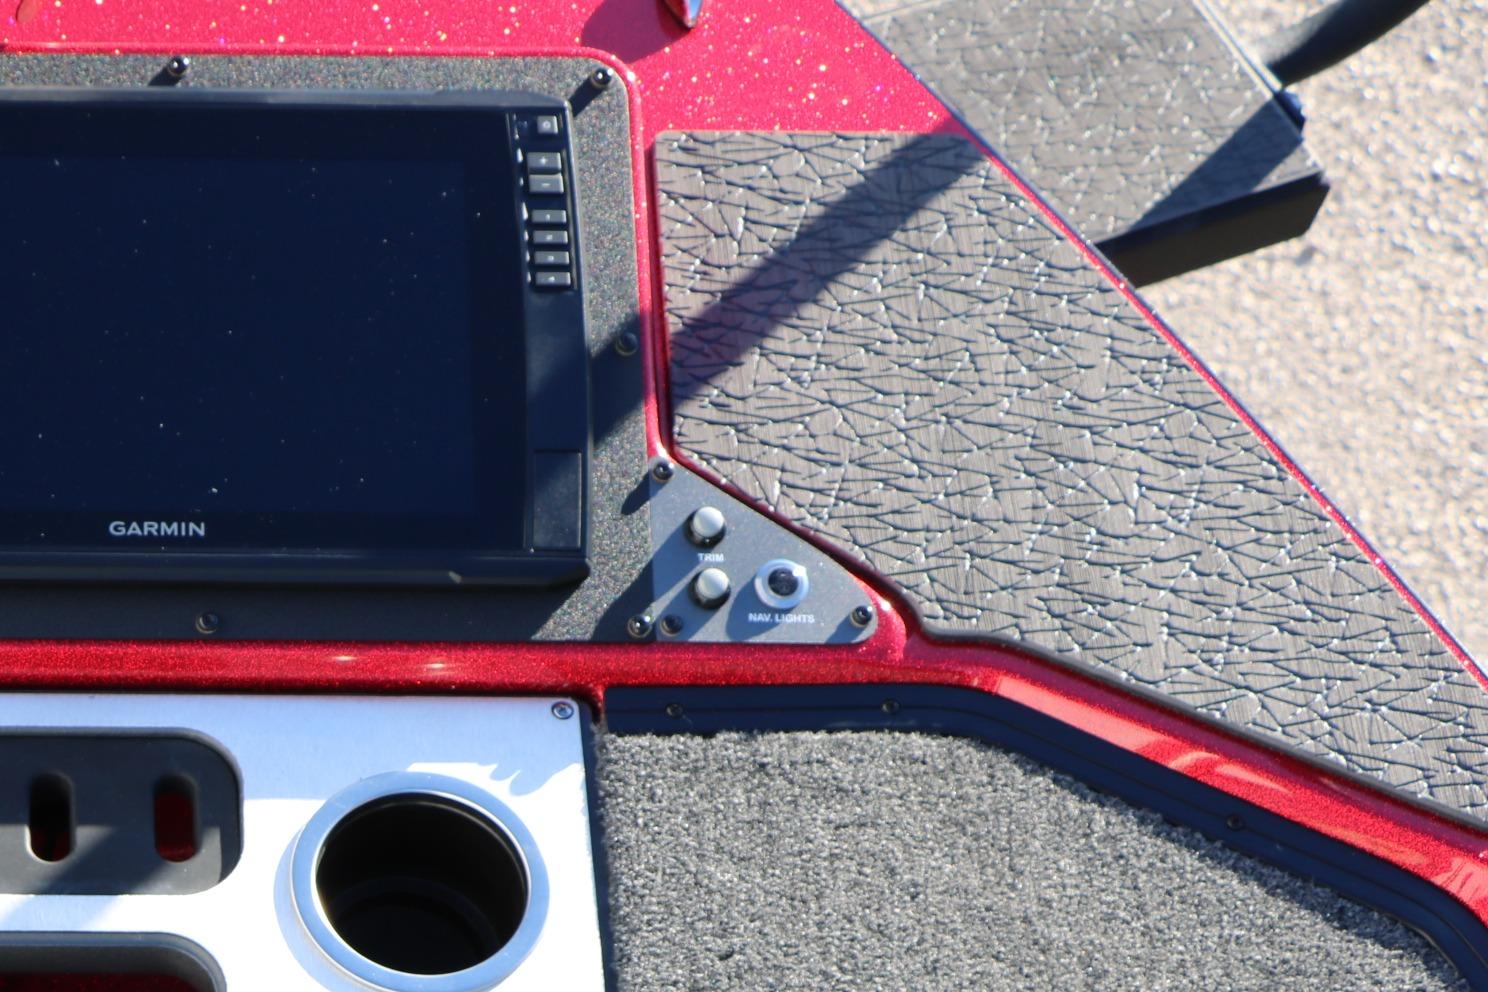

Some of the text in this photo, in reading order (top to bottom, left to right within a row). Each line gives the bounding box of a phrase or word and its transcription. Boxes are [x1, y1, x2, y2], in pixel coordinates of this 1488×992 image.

[108, 520, 206, 538] GARMIN
[697, 552, 725, 562] TRIM
[748, 612, 816, 624] NAV. LIGHTS
